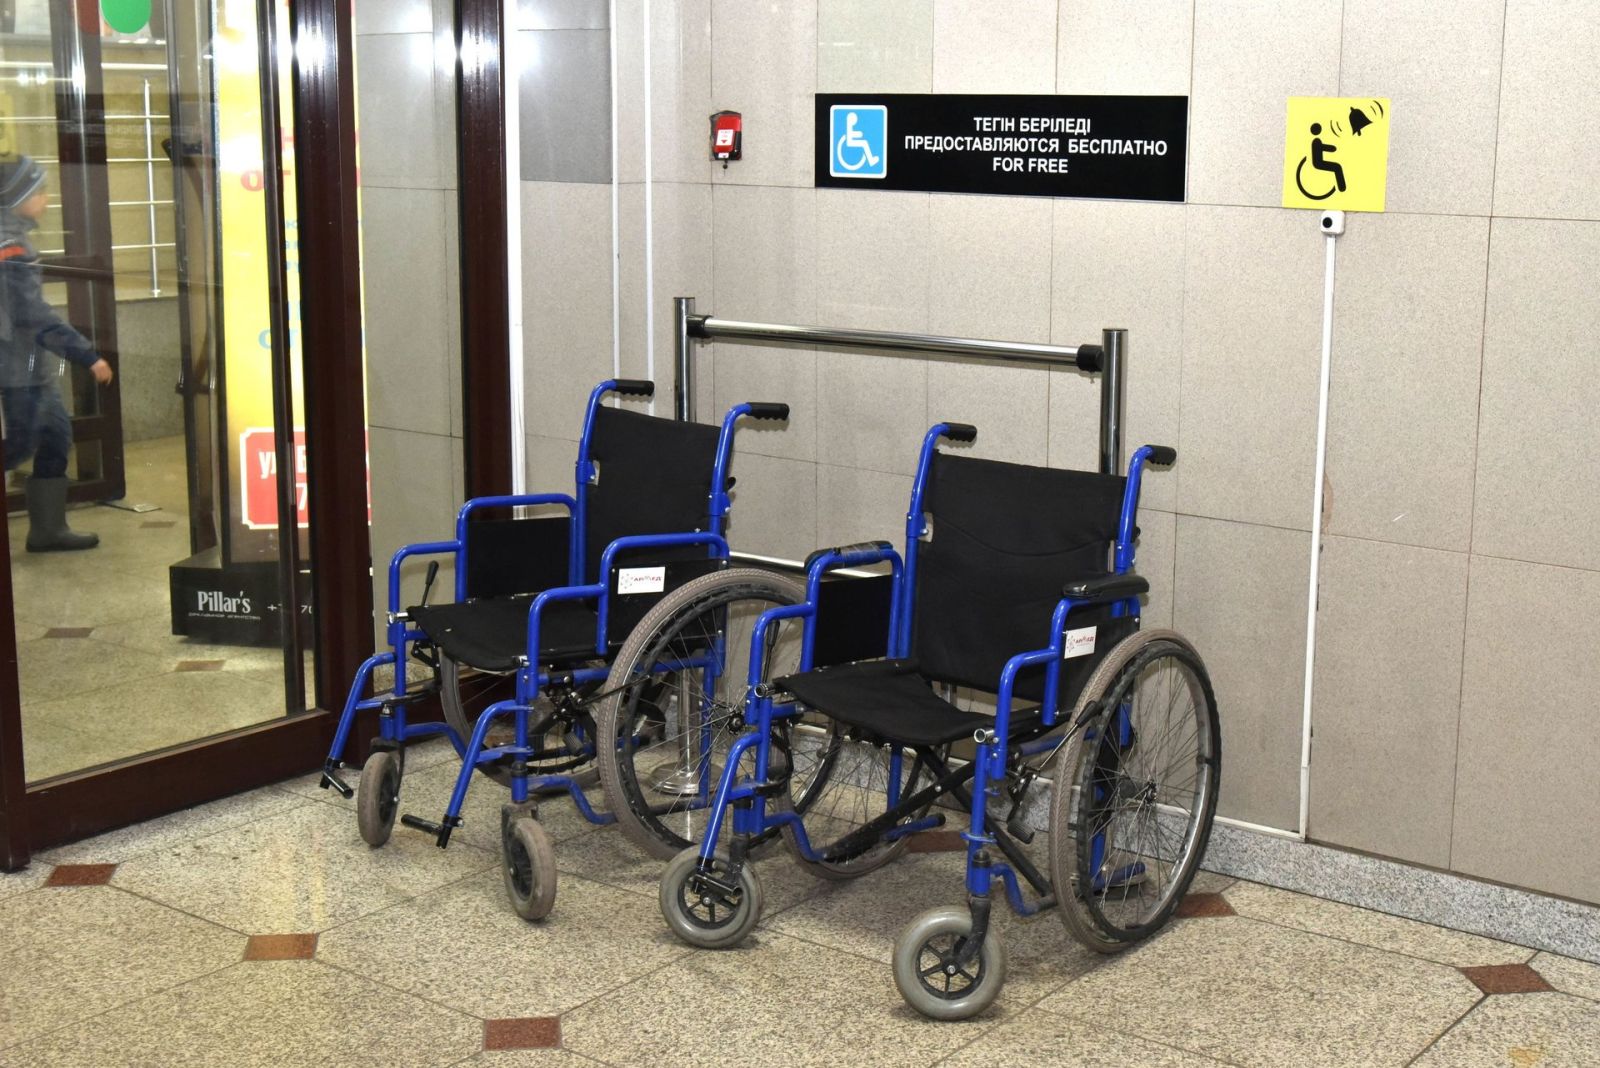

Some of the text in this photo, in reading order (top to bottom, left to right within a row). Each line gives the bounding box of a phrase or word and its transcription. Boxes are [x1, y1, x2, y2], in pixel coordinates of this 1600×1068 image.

[974, 117, 1091, 135] ТЕГІН БЕРІЛЕДІ
[904, 135, 1168, 156] ПРЕДОСТАВЛЯЮТСЯ БЕСПЛАТНО
[992, 156, 1069, 174] FOR FREE
[197, 590, 251, 614] Pillar's
